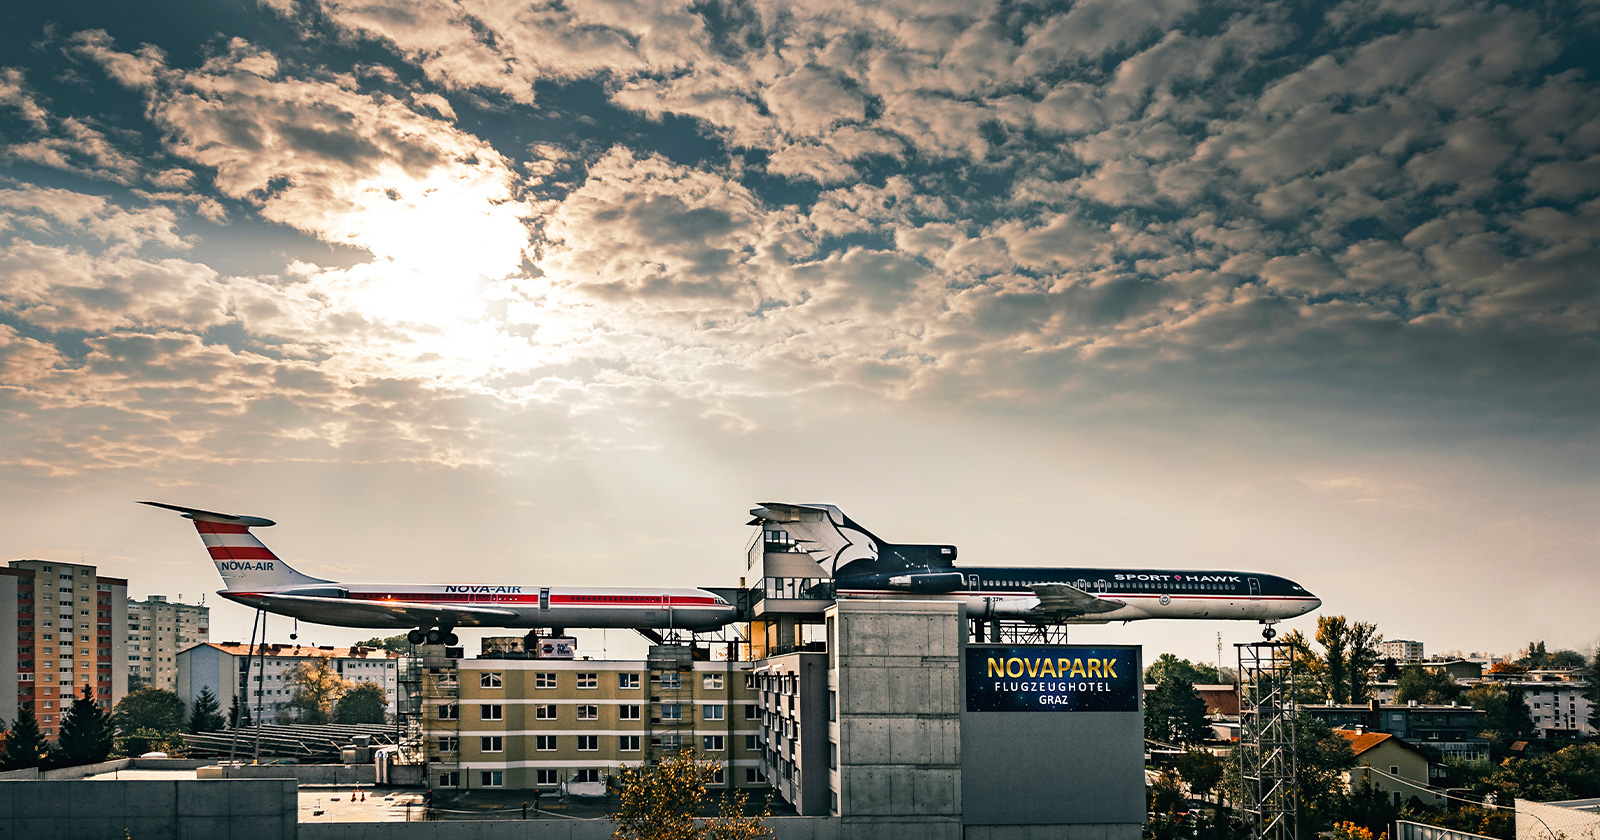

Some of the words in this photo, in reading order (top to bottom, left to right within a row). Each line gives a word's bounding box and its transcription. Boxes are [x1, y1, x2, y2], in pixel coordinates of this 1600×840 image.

[221, 561, 274, 571] NOVA-AIR
[1185, 575, 1241, 583] HAWK
[445, 585, 522, 594] NOVA-AIR
[987, 657, 1118, 679] NOVAPARK
[994, 682, 1111, 692] FLUGZEUGHOTEL
[1039, 695, 1069, 705] GRAZ
